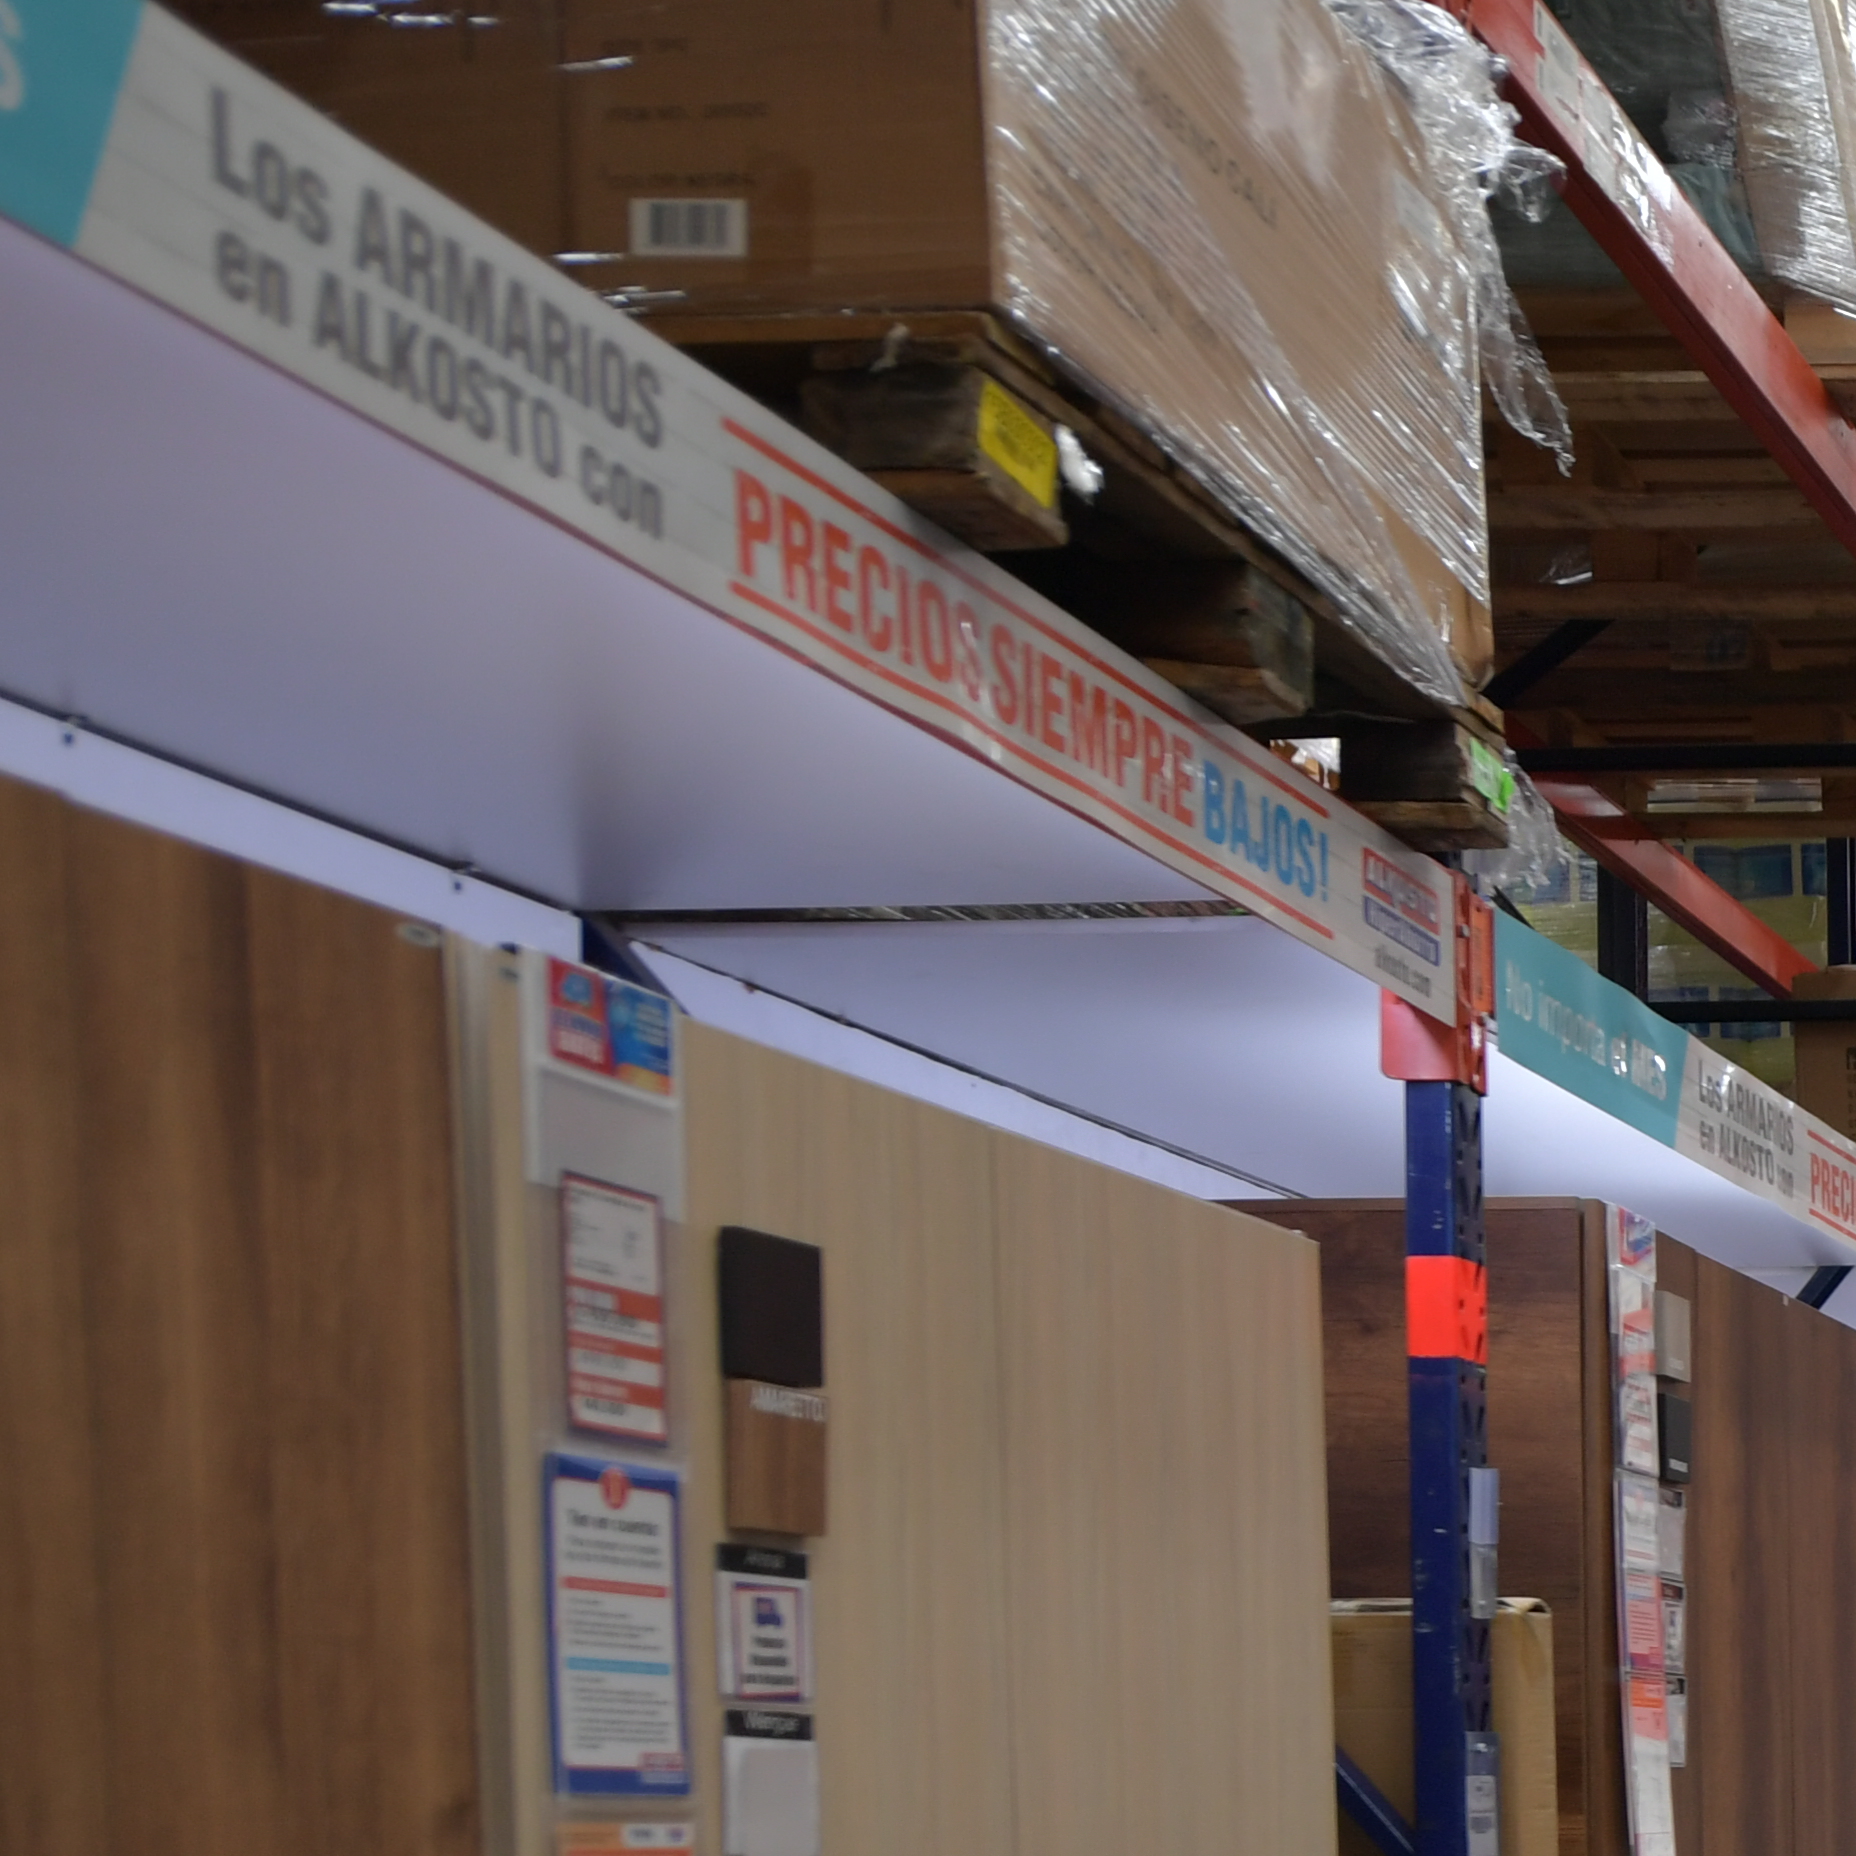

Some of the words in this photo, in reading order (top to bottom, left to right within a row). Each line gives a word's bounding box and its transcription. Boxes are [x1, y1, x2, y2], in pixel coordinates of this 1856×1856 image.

[210, 86, 331, 246] Los
[355, 186, 666, 450] ARMARIOS
[213, 230, 291, 328] en
[314, 270, 564, 480] ALKOSTO
[579, 443, 666, 541] con
[733, 467, 985, 702] PRECIOS
[990, 622, 1196, 828] SIEMPRE
[1202, 757, 1329, 902] BAJOS!
[1718, 1123, 1775, 1186] ALKOSTO
[1727, 1079, 1794, 1156] ARMARIOS
